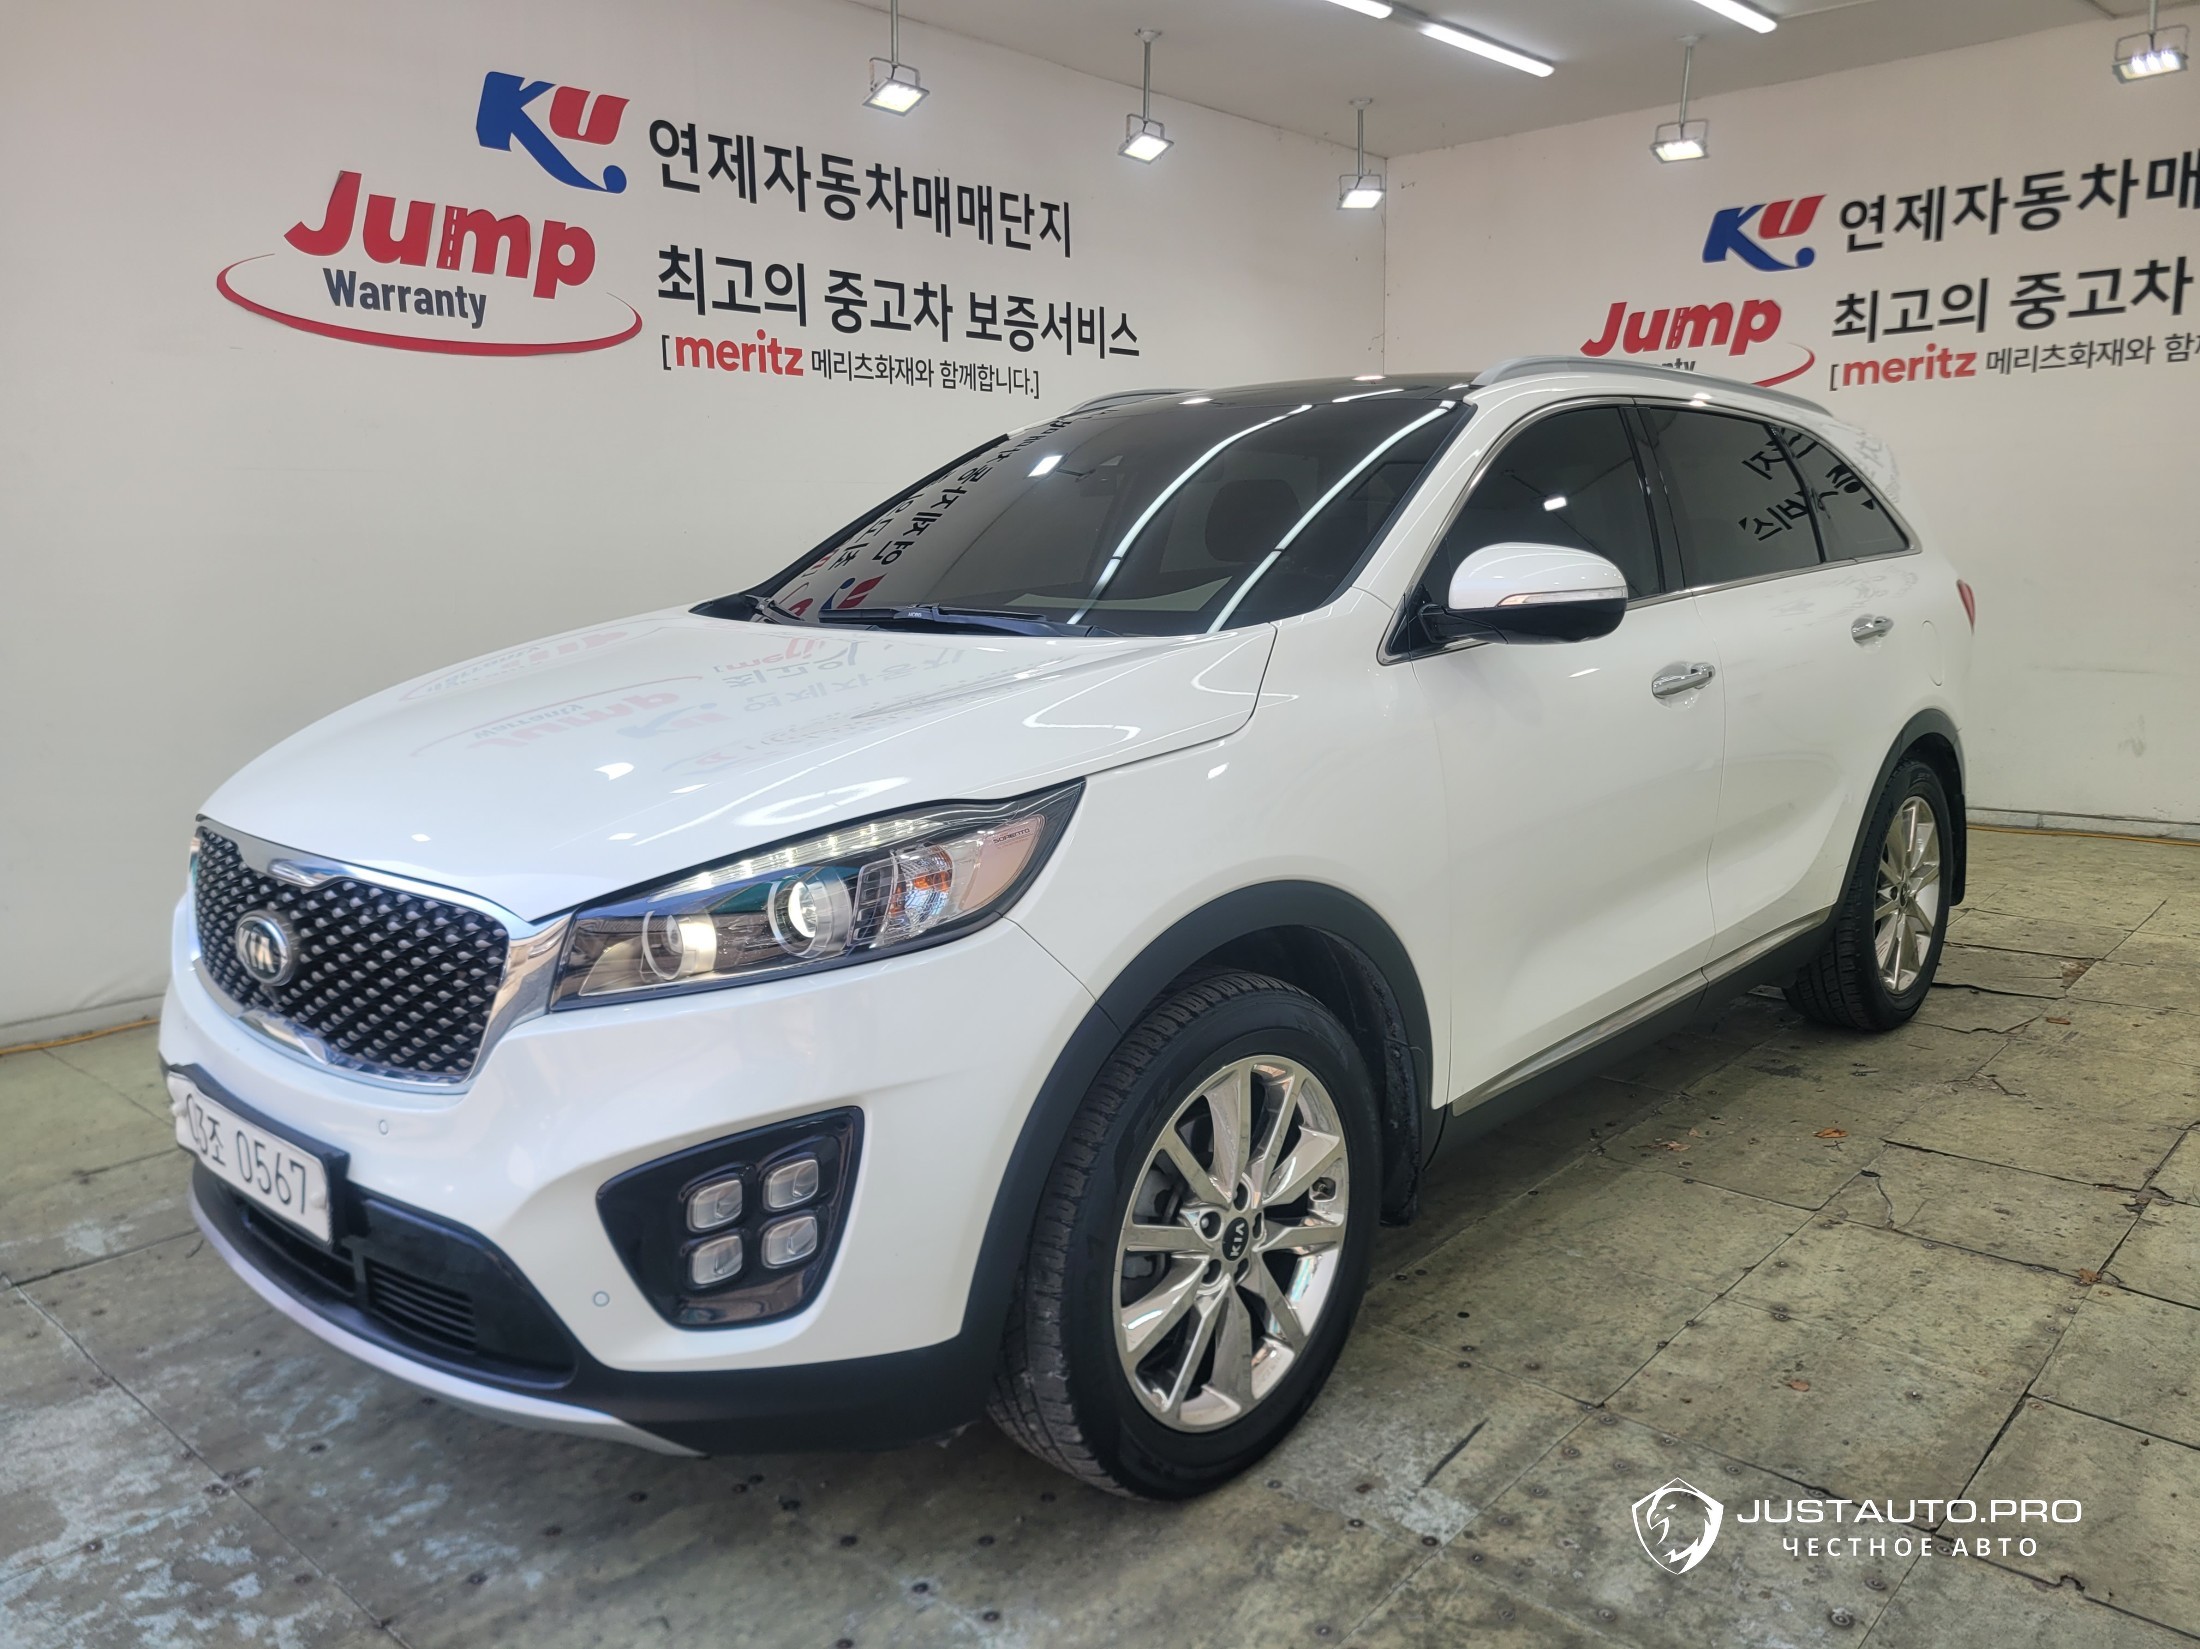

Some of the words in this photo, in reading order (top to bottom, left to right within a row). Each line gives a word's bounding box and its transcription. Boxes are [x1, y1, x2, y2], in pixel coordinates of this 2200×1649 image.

[649, 118, 1072, 258] 연제자동차매매단지
[284, 170, 596, 299] Jump
[323, 267, 487, 329] Warranty
[657, 245, 807, 327] 최고의
[825, 269, 953, 343] 중고차
[966, 292, 1140, 359] 보증서비스
[1580, 299, 1781, 357] Jump
[1832, 277, 1990, 344] 최고의
[2010, 256, 2194, 330] 중고차
[811, 349, 934, 389] 메리츠화재와
[940, 360, 1040, 399] 함께합니다.]
[1986, 335, 2155, 375] 메리츠화재와
[2164, 332, 2200, 363] 함
[236, 1130, 306, 1215] 0567
[1230, 1222, 1246, 1257] KIA
